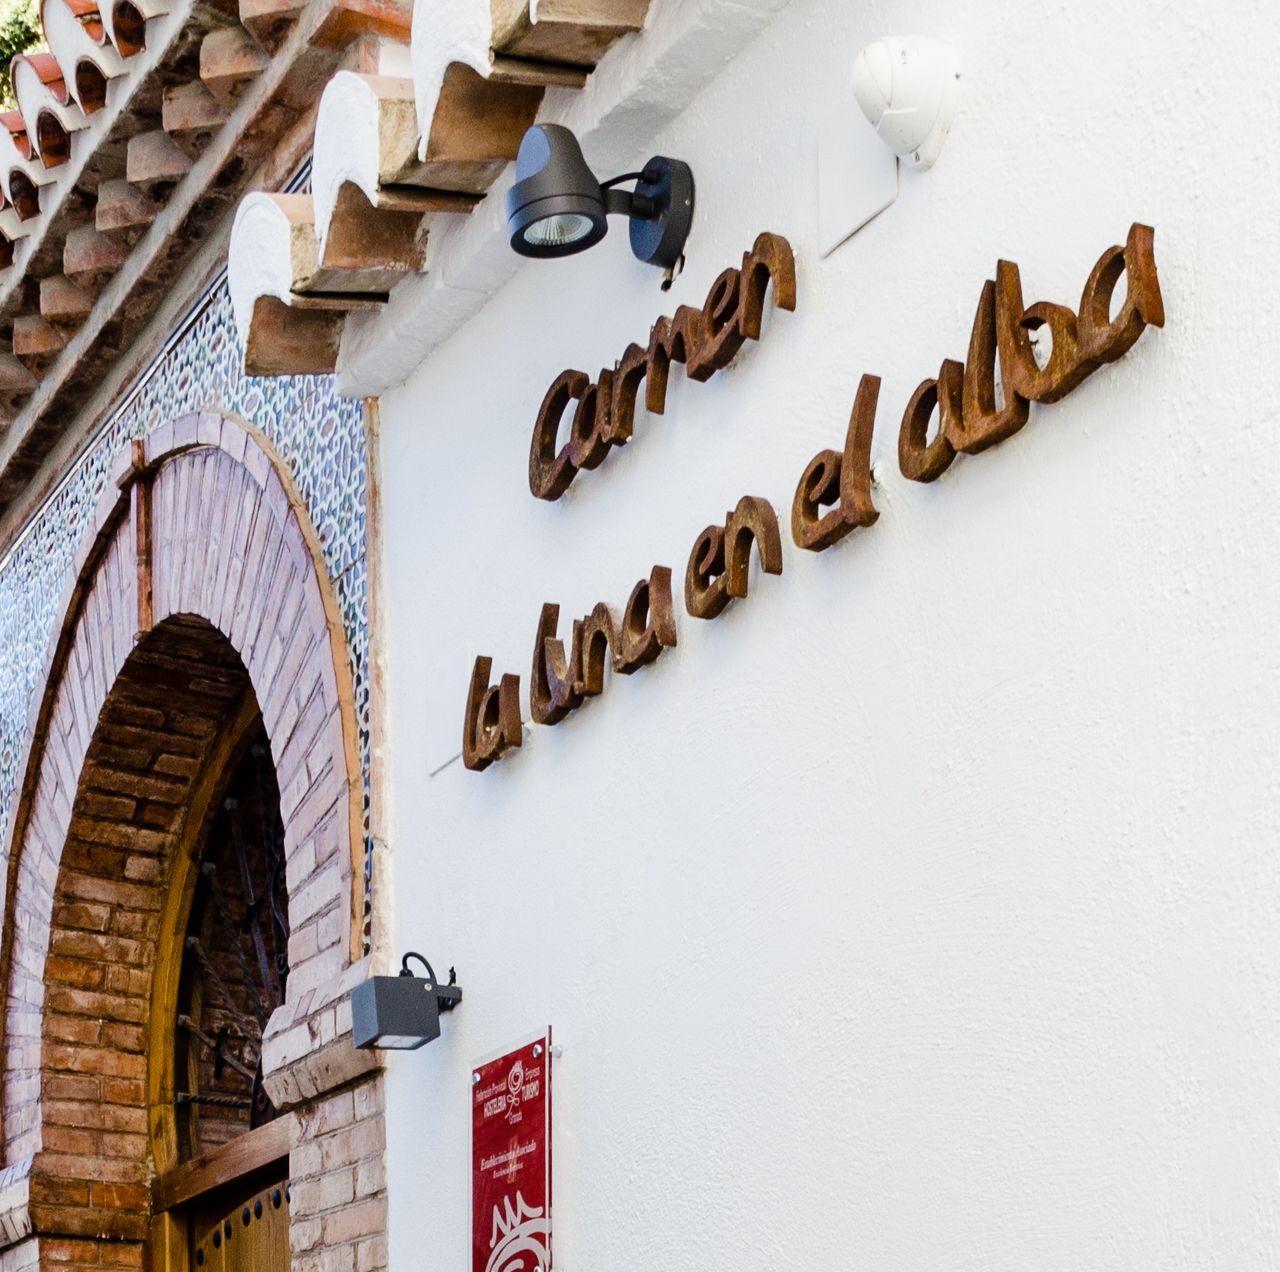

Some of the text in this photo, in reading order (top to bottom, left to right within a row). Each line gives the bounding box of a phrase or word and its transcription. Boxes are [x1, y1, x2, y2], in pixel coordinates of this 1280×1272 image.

[684, 495, 783, 620] en
[790, 372, 881, 552] el
[898, 222, 1165, 484] alba
